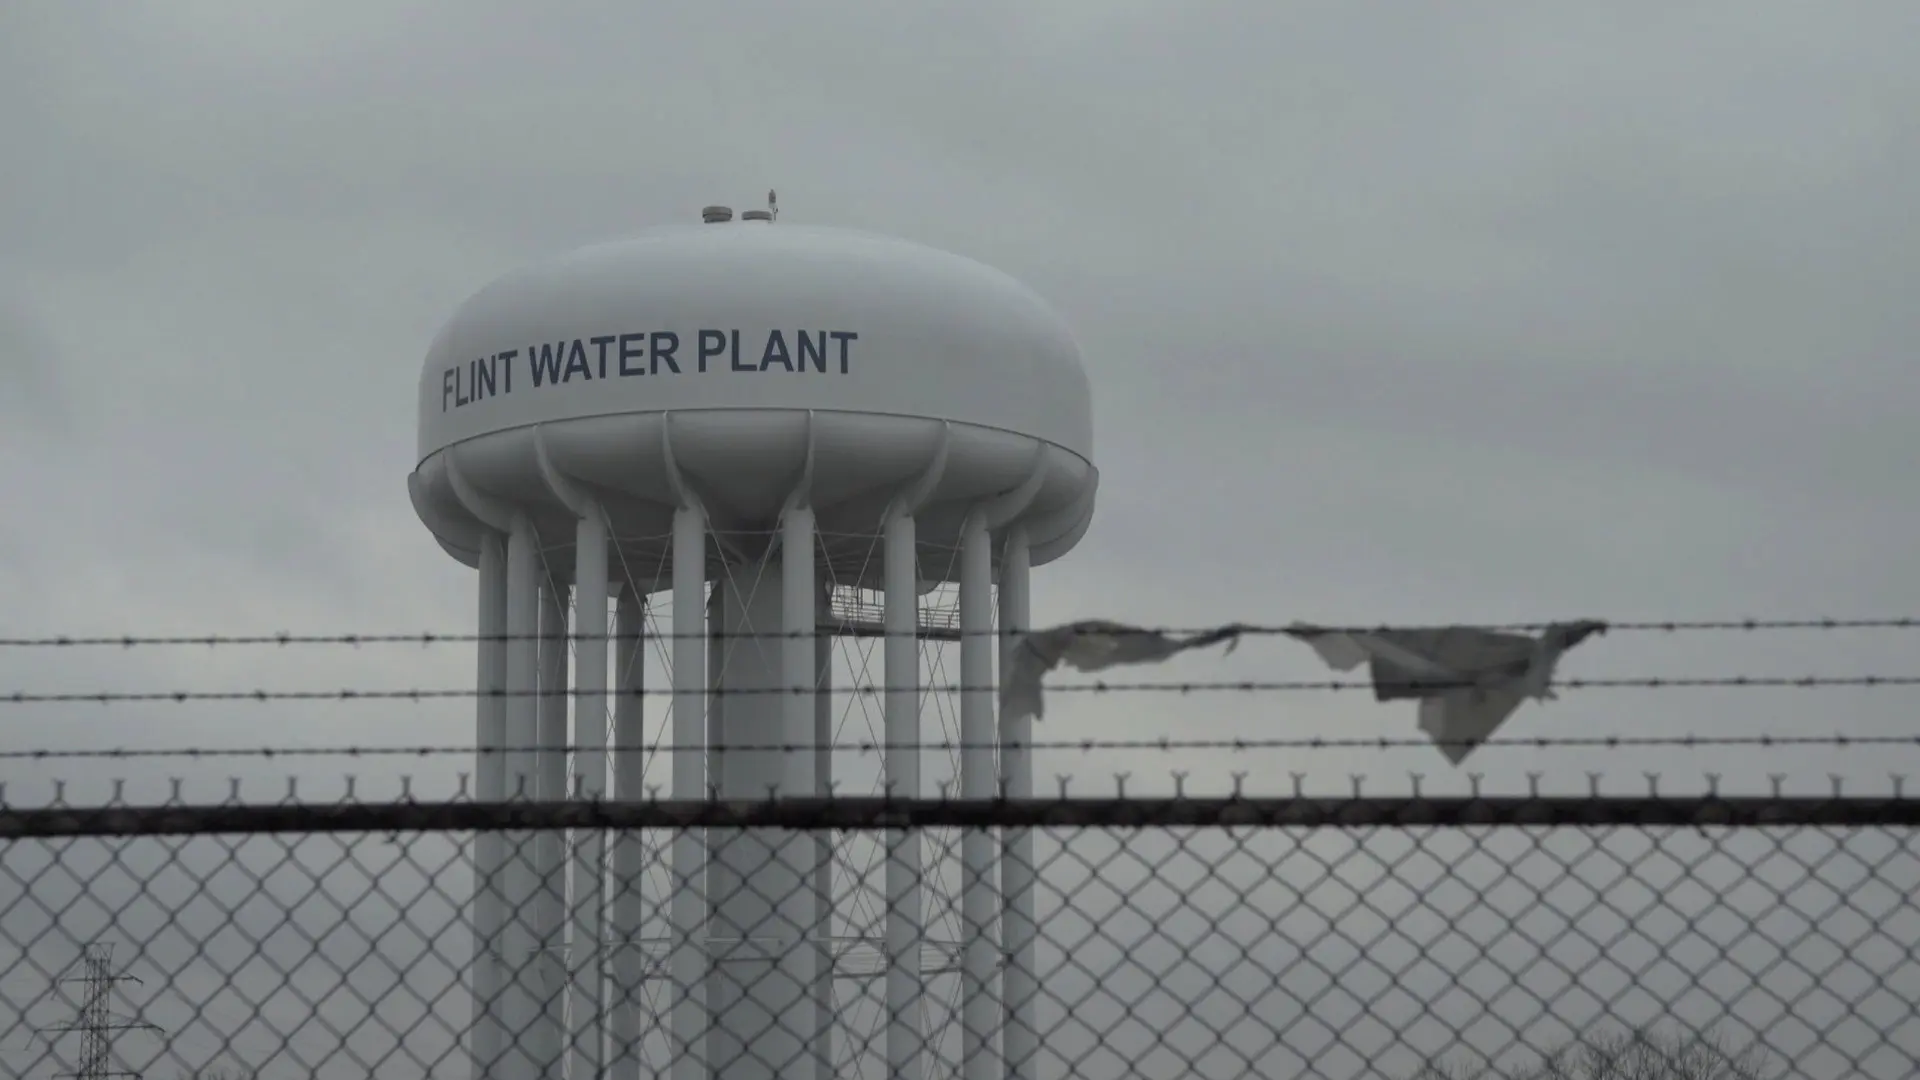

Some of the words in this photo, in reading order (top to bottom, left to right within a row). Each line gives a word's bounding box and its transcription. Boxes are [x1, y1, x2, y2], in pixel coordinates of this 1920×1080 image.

[442, 349, 519, 412] FLINT
[528, 331, 682, 387] WATER
[698, 329, 859, 375] PLANT
